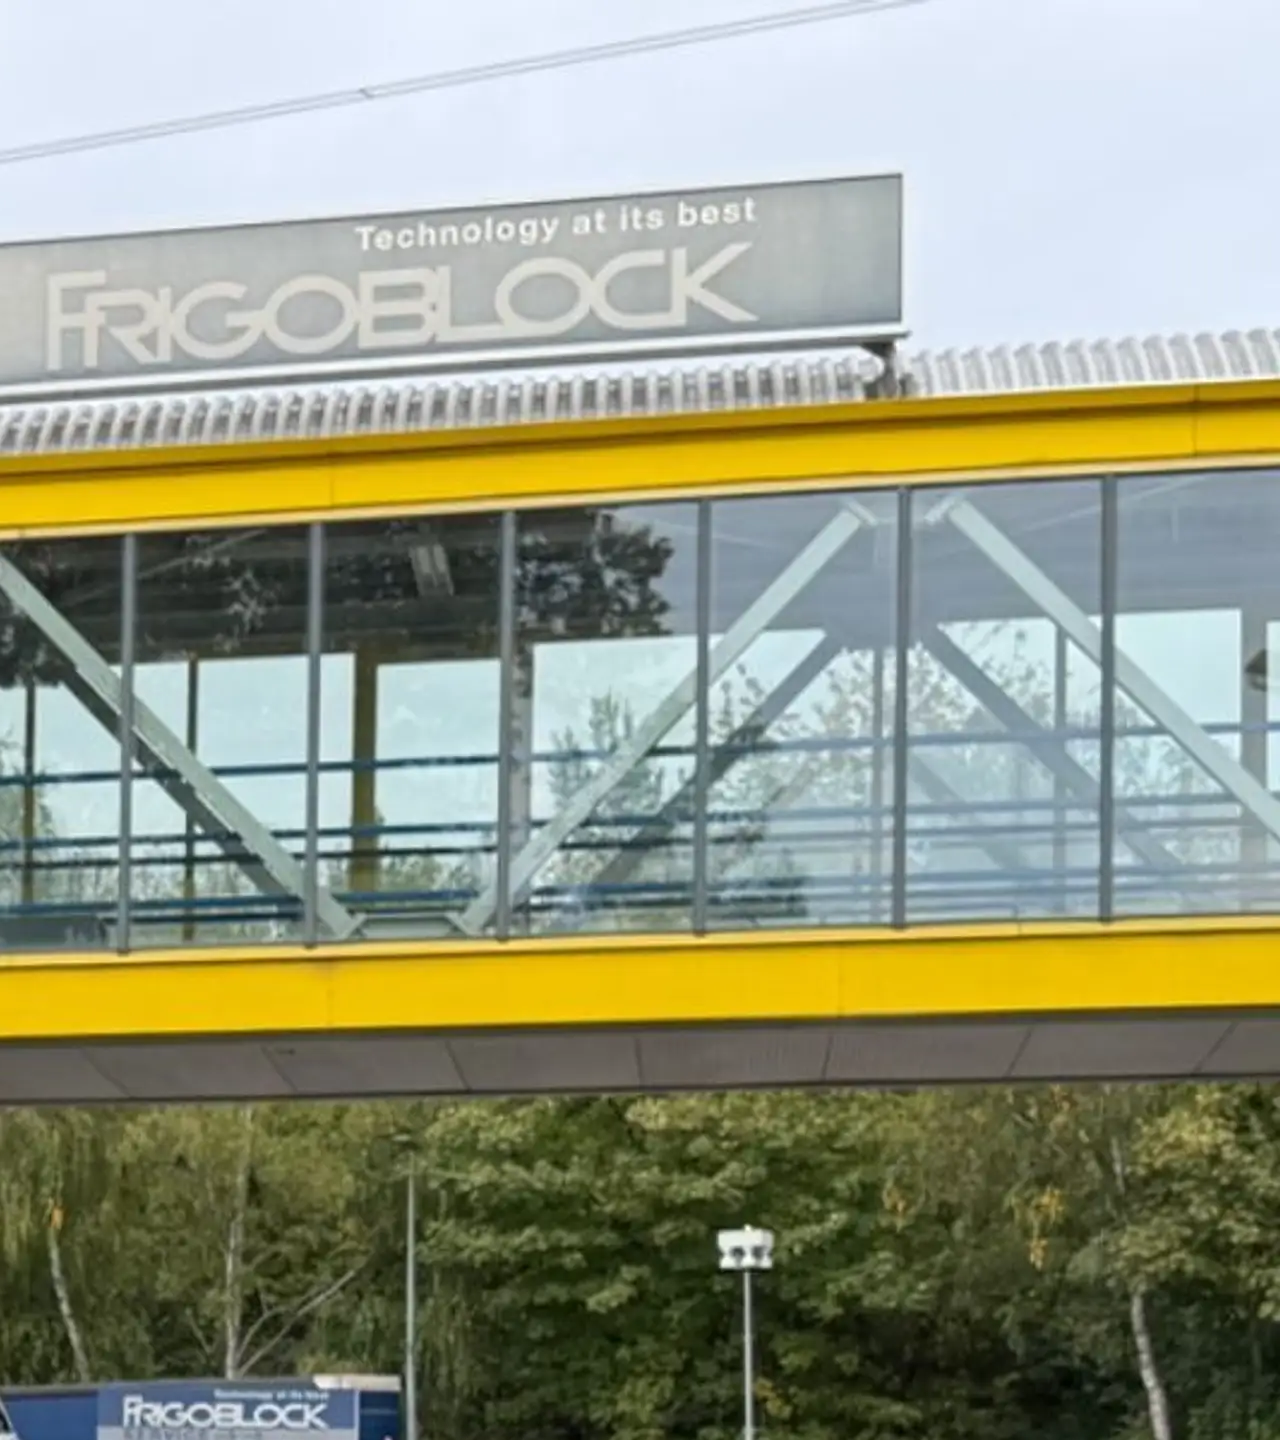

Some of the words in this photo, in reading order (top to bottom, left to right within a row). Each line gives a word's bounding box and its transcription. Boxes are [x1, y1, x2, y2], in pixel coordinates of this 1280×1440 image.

[355, 215, 560, 252] Technology
[573, 207, 607, 236] at
[620, 203, 664, 232] its
[677, 197, 758, 228] best
[45, 242, 760, 371] FRIGOBLOCK
[123, 1394, 331, 1429] FRIGOBLOCK
